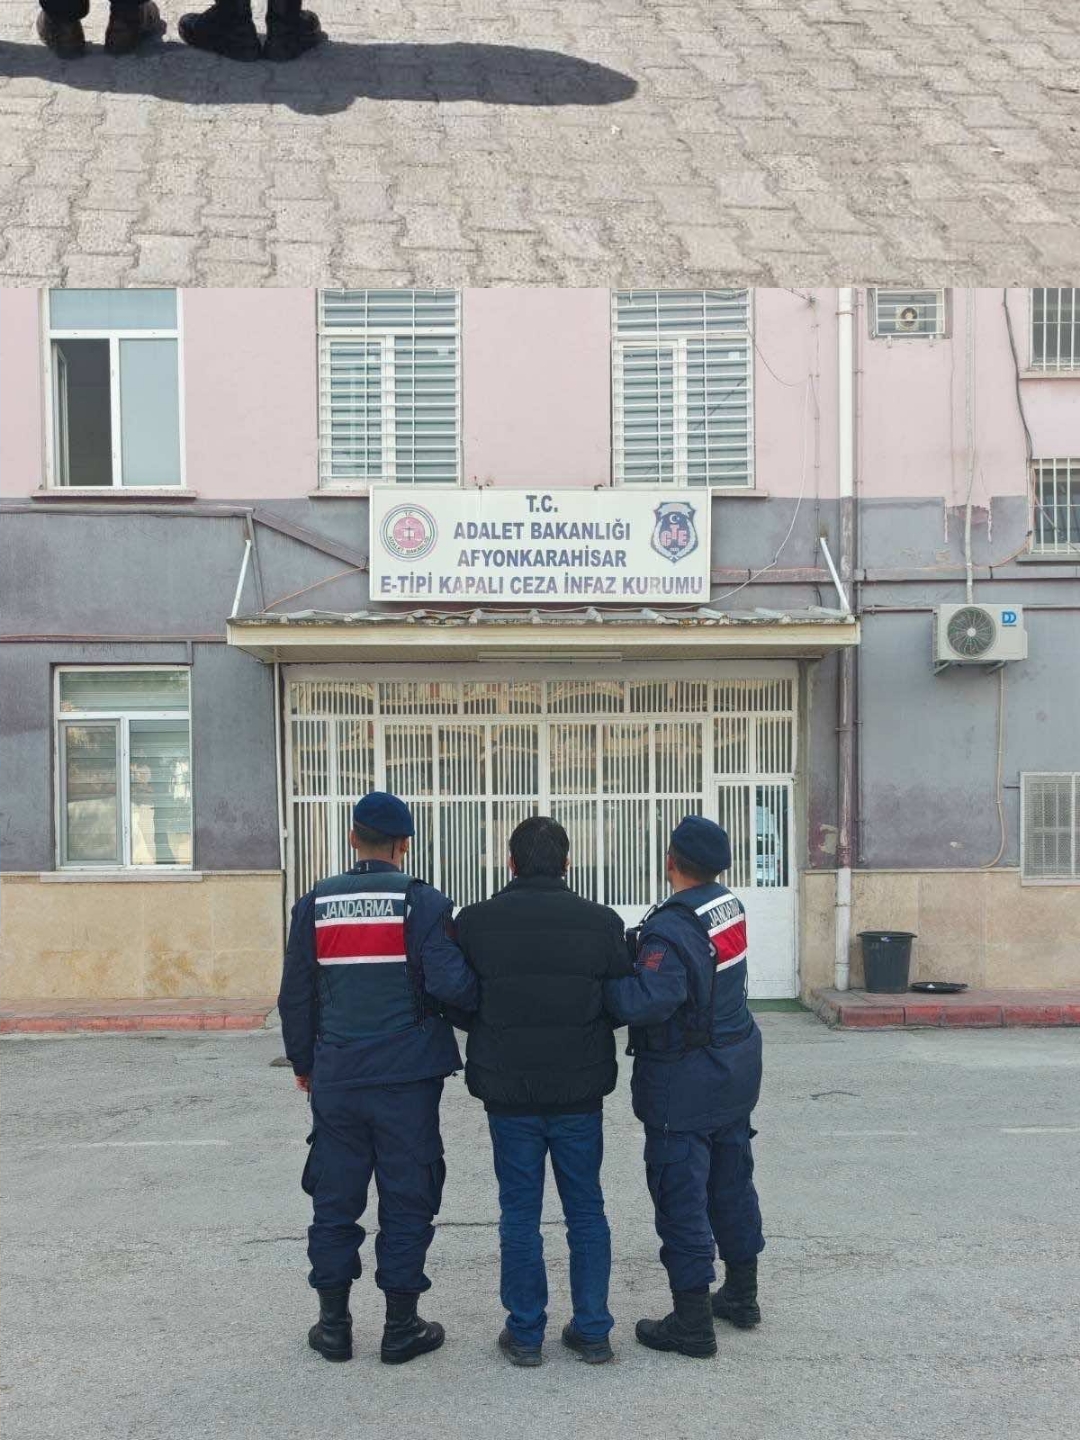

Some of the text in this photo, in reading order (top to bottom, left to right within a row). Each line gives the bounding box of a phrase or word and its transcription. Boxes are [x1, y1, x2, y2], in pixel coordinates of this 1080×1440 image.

[526, 495, 558, 513] T.C.
[454, 519, 630, 540] ADALET BAKANLIĞI
[457, 546, 627, 567] AFYONKARAHİSAR
[381, 572, 702, 594] E-TİPİ KAPALI CEZA İNFAZ KURUMU
[321, 899, 394, 920] JANDARMA
